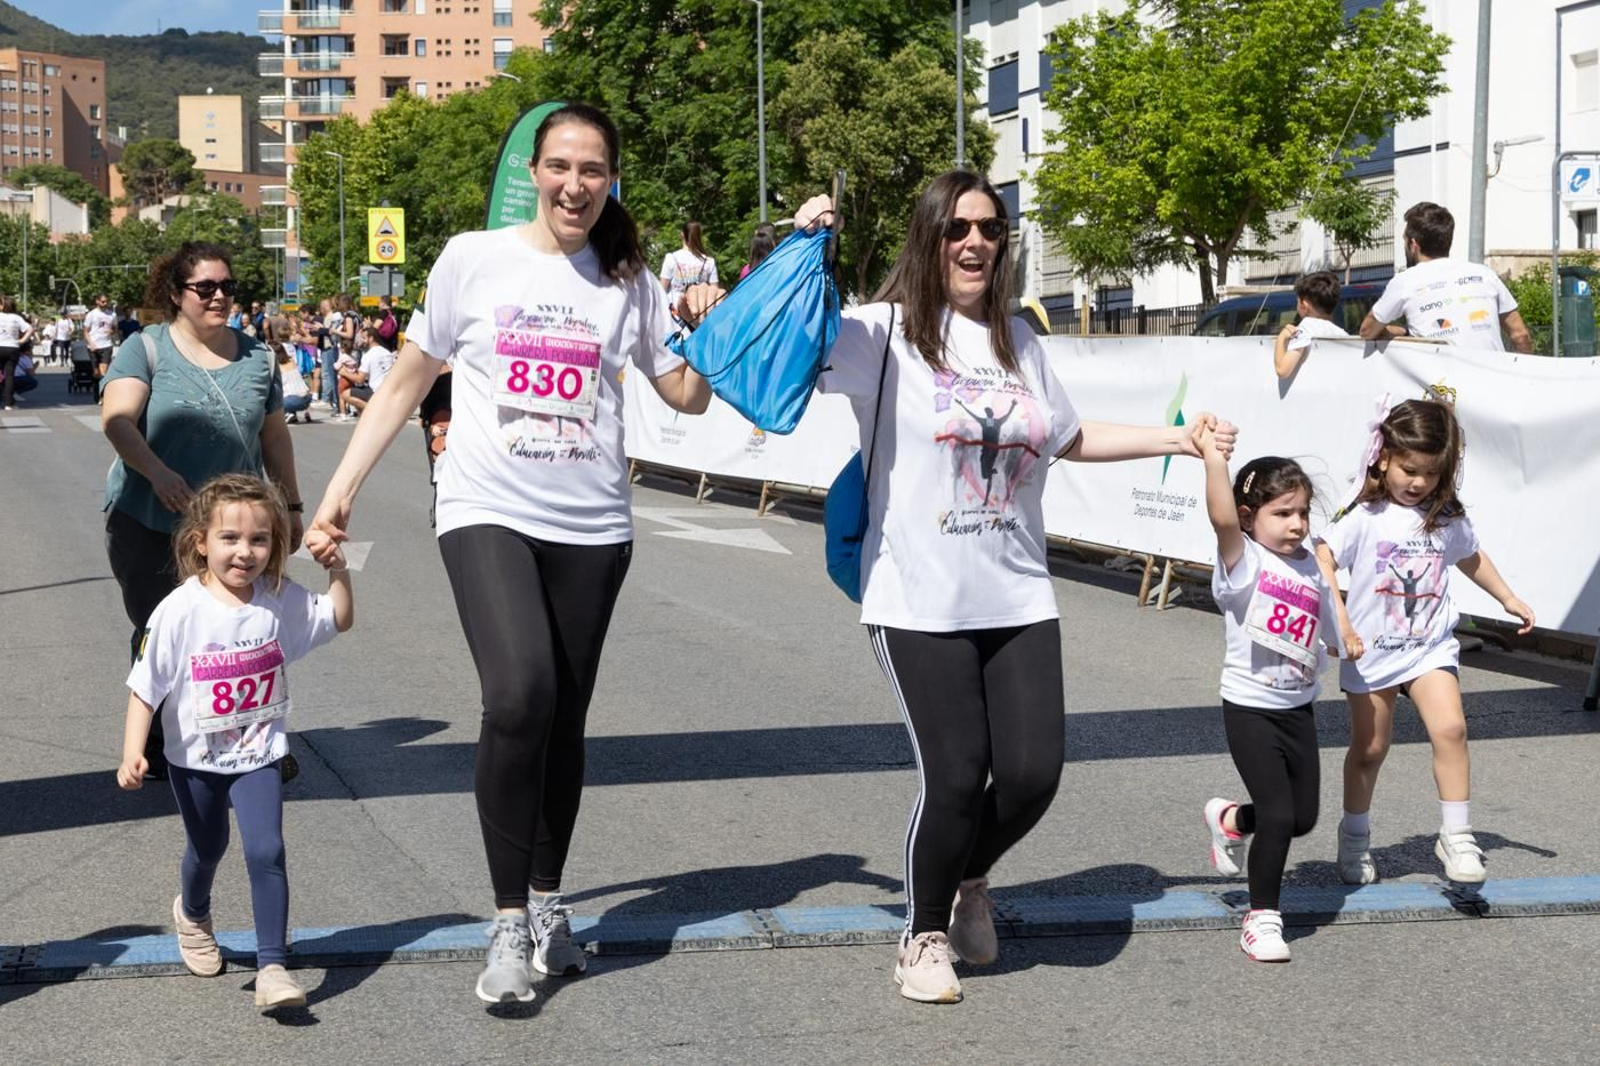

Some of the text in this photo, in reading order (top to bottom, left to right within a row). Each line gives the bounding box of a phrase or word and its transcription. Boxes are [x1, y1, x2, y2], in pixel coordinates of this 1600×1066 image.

[381, 245, 394, 253] 20
[536, 304, 575, 315] XXVII
[1419, 300, 1443, 313] sano
[500, 331, 543, 347] XXVII
[500, 342, 597, 367] CARRERA POPULAR
[507, 360, 583, 400] 830
[973, 367, 1011, 378] XXVII
[1157, 490, 1188, 508] Municipal
[1188, 495, 1198, 508] de
[1134, 503, 1185, 521] Deportes de Jaén
[1264, 571, 1302, 594] XXVII
[1266, 602, 1318, 649] 841
[234, 637, 265, 648] XXVII
[195, 653, 237, 668] XXVII
[196, 664, 244, 681] CARRERA
[212, 671, 276, 715] 827
